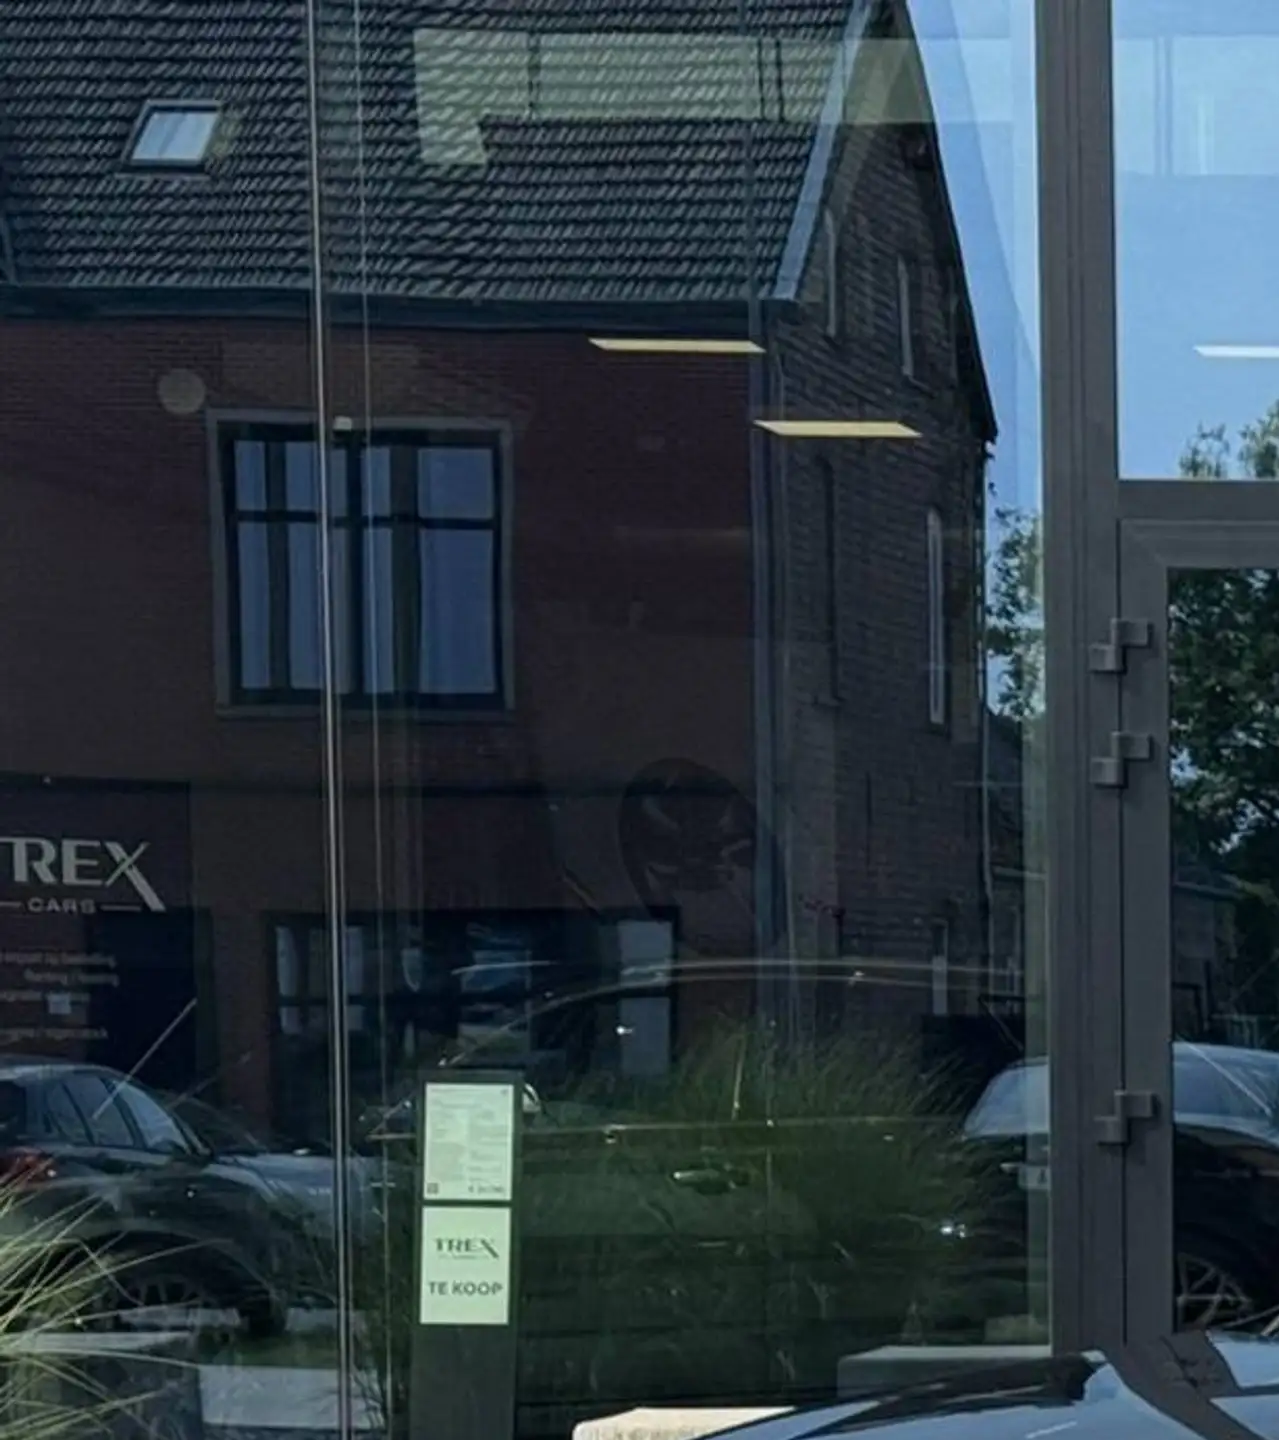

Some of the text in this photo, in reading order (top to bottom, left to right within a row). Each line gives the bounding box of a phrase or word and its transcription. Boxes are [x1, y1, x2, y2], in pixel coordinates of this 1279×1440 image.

[0, 836, 166, 912] REX
[433, 1238, 499, 1259] TREX
[428, 1281, 503, 1296] TE KOOP
